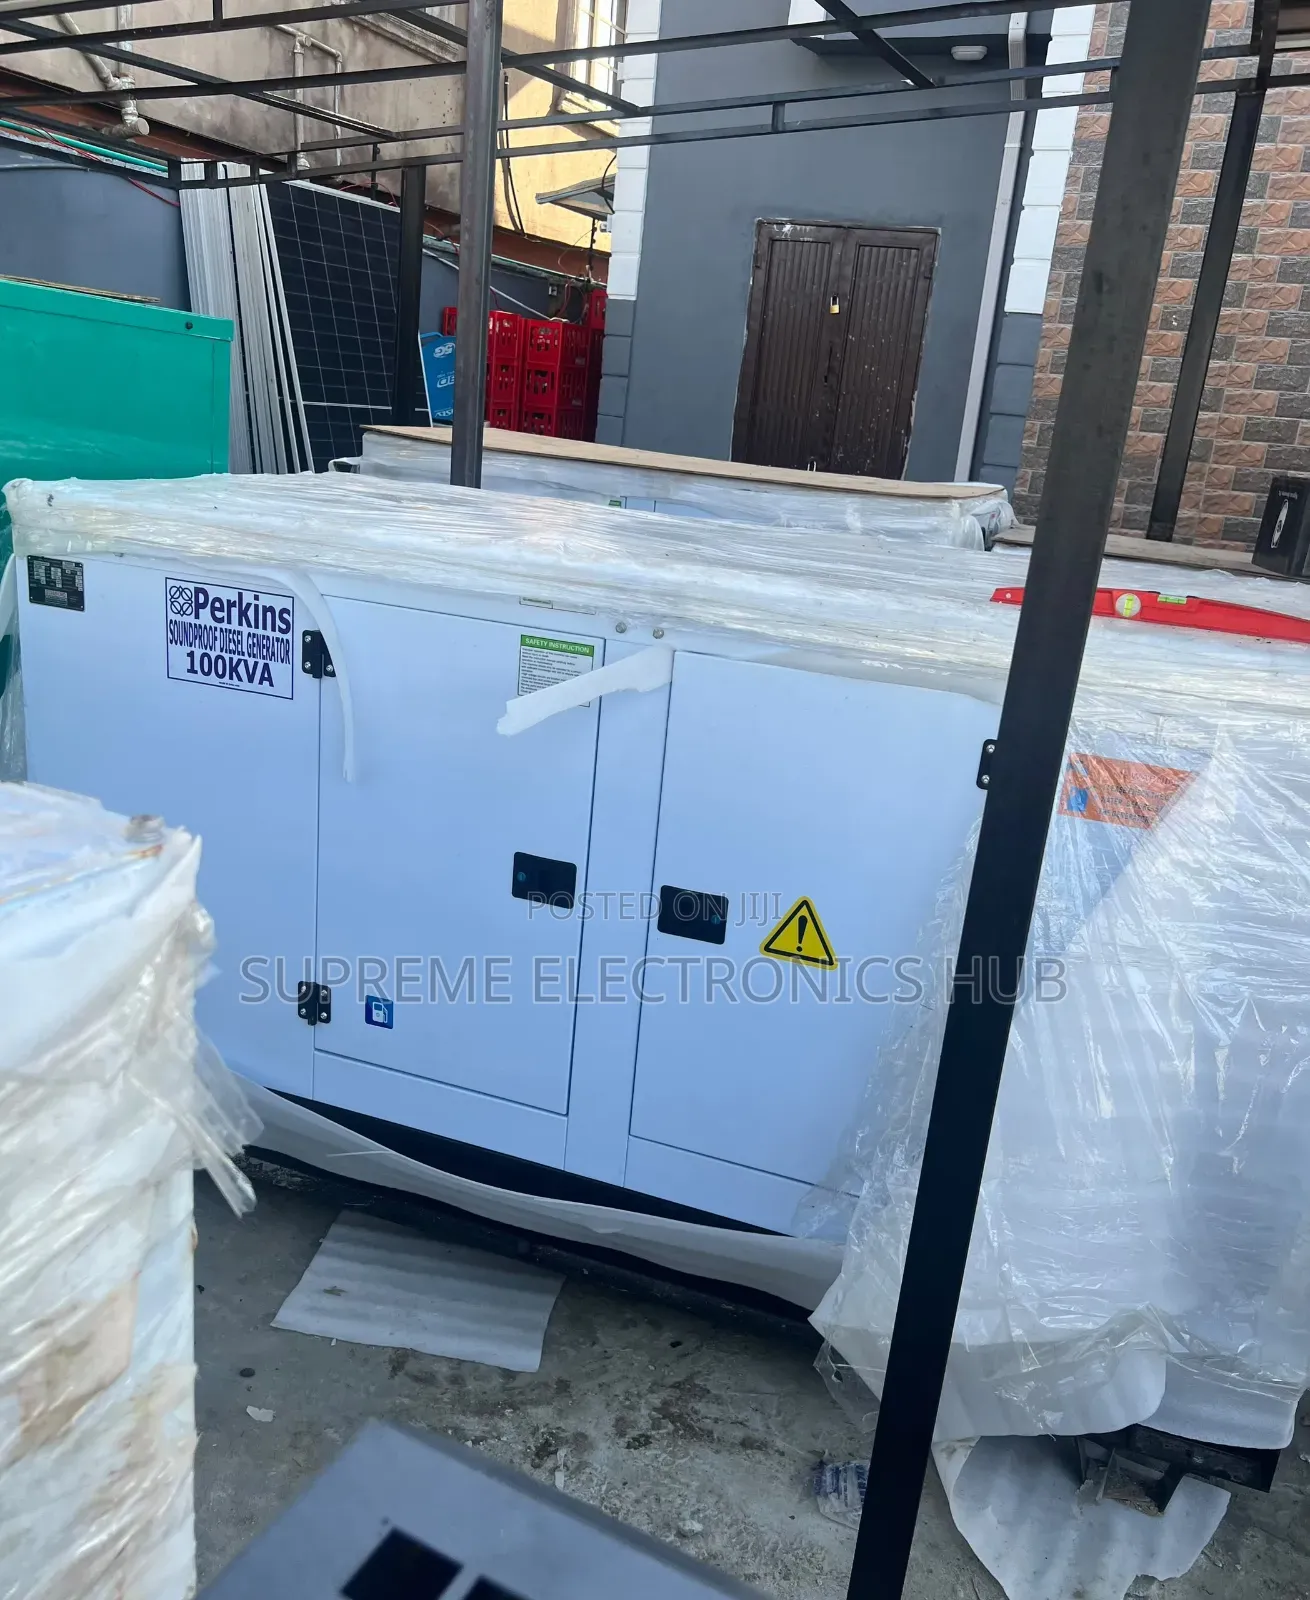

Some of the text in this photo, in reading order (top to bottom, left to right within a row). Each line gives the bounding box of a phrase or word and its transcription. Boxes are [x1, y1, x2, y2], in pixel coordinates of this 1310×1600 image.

[194, 586, 291, 634] Perkins
[169, 618, 291, 665] SOUNDPROOF DIESEL GENERATOR
[525, 637, 590, 653] SAFETY INSTRUCTION
[186, 650, 275, 687] 100KVA
